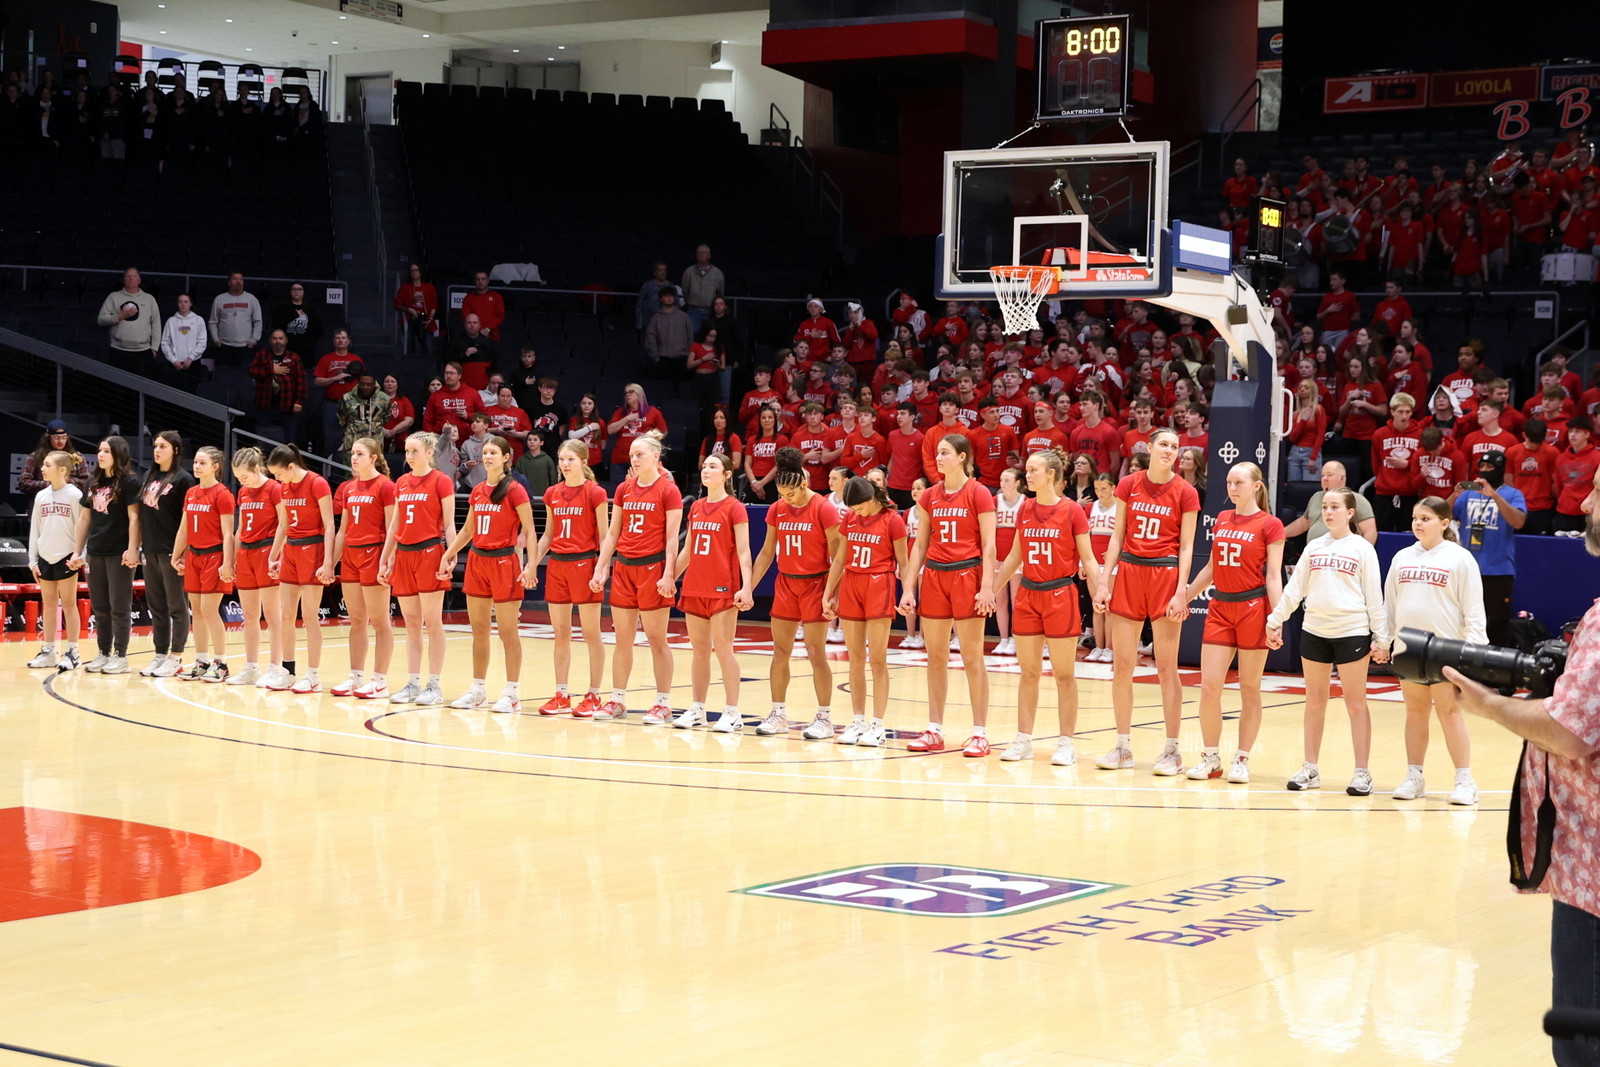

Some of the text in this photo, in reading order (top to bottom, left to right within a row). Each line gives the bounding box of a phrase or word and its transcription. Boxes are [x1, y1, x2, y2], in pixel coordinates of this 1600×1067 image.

[1066, 26, 1120, 56] 8:00
[1455, 78, 1512, 96] LOYOLA
[1061, 108, 1104, 116] DAKTRONICS
[1556, 86, 1592, 129] B
[1493, 99, 1530, 141] B
[328, 292, 341, 300] 107
[999, 405, 1022, 418] ELLEVUE
[1028, 437, 1052, 447] BELLEVUE
[1383, 436, 1420, 450] BELLEVUE
[347, 495, 374, 504] BELLEVUE
[399, 493, 428, 502] BELLEVUE
[623, 501, 655, 511] BELLEVUE
[352, 505, 360, 525] 4
[405, 504, 415, 524] 5
[474, 503, 502, 512] BELLEVUE
[553, 506, 583, 516] BELLEVUE
[932, 507, 968, 518] BELLEVUE
[1131, 501, 1172, 516] BELLEVUE
[193, 514, 198, 533] 1
[246, 512, 254, 531] 2
[289, 509, 299, 527] 3
[477, 515, 491, 535] 10
[628, 513, 644, 533] 12
[692, 521, 721, 531] BELLEVUE
[778, 521, 812, 532] BELLEVUE
[559, 518, 571, 539] 11
[939, 520, 957, 543] 21
[1024, 528, 1060, 538] BELLEVUE
[1133, 515, 1160, 540] 30
[1216, 529, 1255, 543] BELLEVUE
[693, 533, 711, 556] 13
[785, 534, 802, 556] 14
[847, 532, 881, 545] BELLEVUE
[851, 545, 872, 568] 20
[1028, 541, 1053, 565] 24
[1217, 541, 1242, 566] 32
[225, 605, 244, 616] Kro
[932, 875, 1286, 960] FIFTH THIRD
[1124, 903, 1315, 948] BANK
